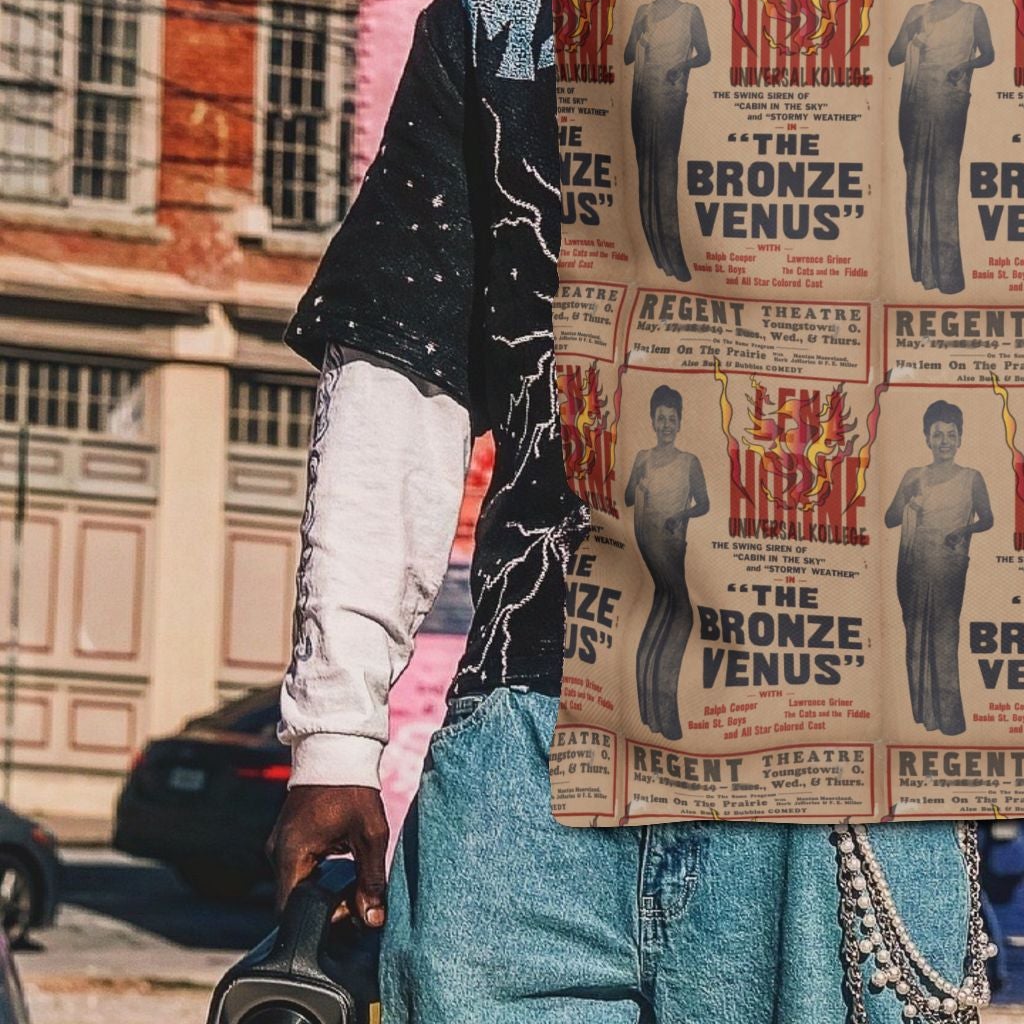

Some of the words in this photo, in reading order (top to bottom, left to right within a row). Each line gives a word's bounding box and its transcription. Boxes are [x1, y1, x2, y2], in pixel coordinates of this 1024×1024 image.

[730, 67, 806, 88] UNIVERSAL
[713, 91, 730, 99] THE
[733, 91, 764, 99] SWING
[767, 92, 794, 100] SIREN
[797, 92, 810, 100] OF
[734, 102, 767, 110] “CABIN
[770, 102, 779, 110] IN
[784, 102, 801, 110] THE
[805, 103, 828, 111] SKY”
[766, 113, 808, 121] “STORMY
[813, 114, 861, 122] WEATHER”
[787, 123, 797, 131] IN
[728, 133, 819, 155] “THE
[687, 160, 863, 198] BRONZE
[694, 202, 864, 240] VENUS”
[757, 244, 781, 252] WITH
[989, 257, 1011, 267] Ralph
[997, 270, 1008, 279] St.
[1009, 282, 1023, 292] and
[639, 294, 744, 326] REGENT
[761, 306, 861, 321] THEATRE
[896, 338, 925, 349] May.
[949, 360, 967, 370] On
[973, 360, 997, 370] The
[728, 516, 804, 542] UNIVERSAL
[727, 583, 818, 609] “THE
[697, 605, 862, 650] BRONZE
[703, 647, 864, 688] VENUS”
[759, 690, 783, 698] WITH
[634, 746, 743, 782] REGENT
[762, 750, 864, 767] THEATRE
